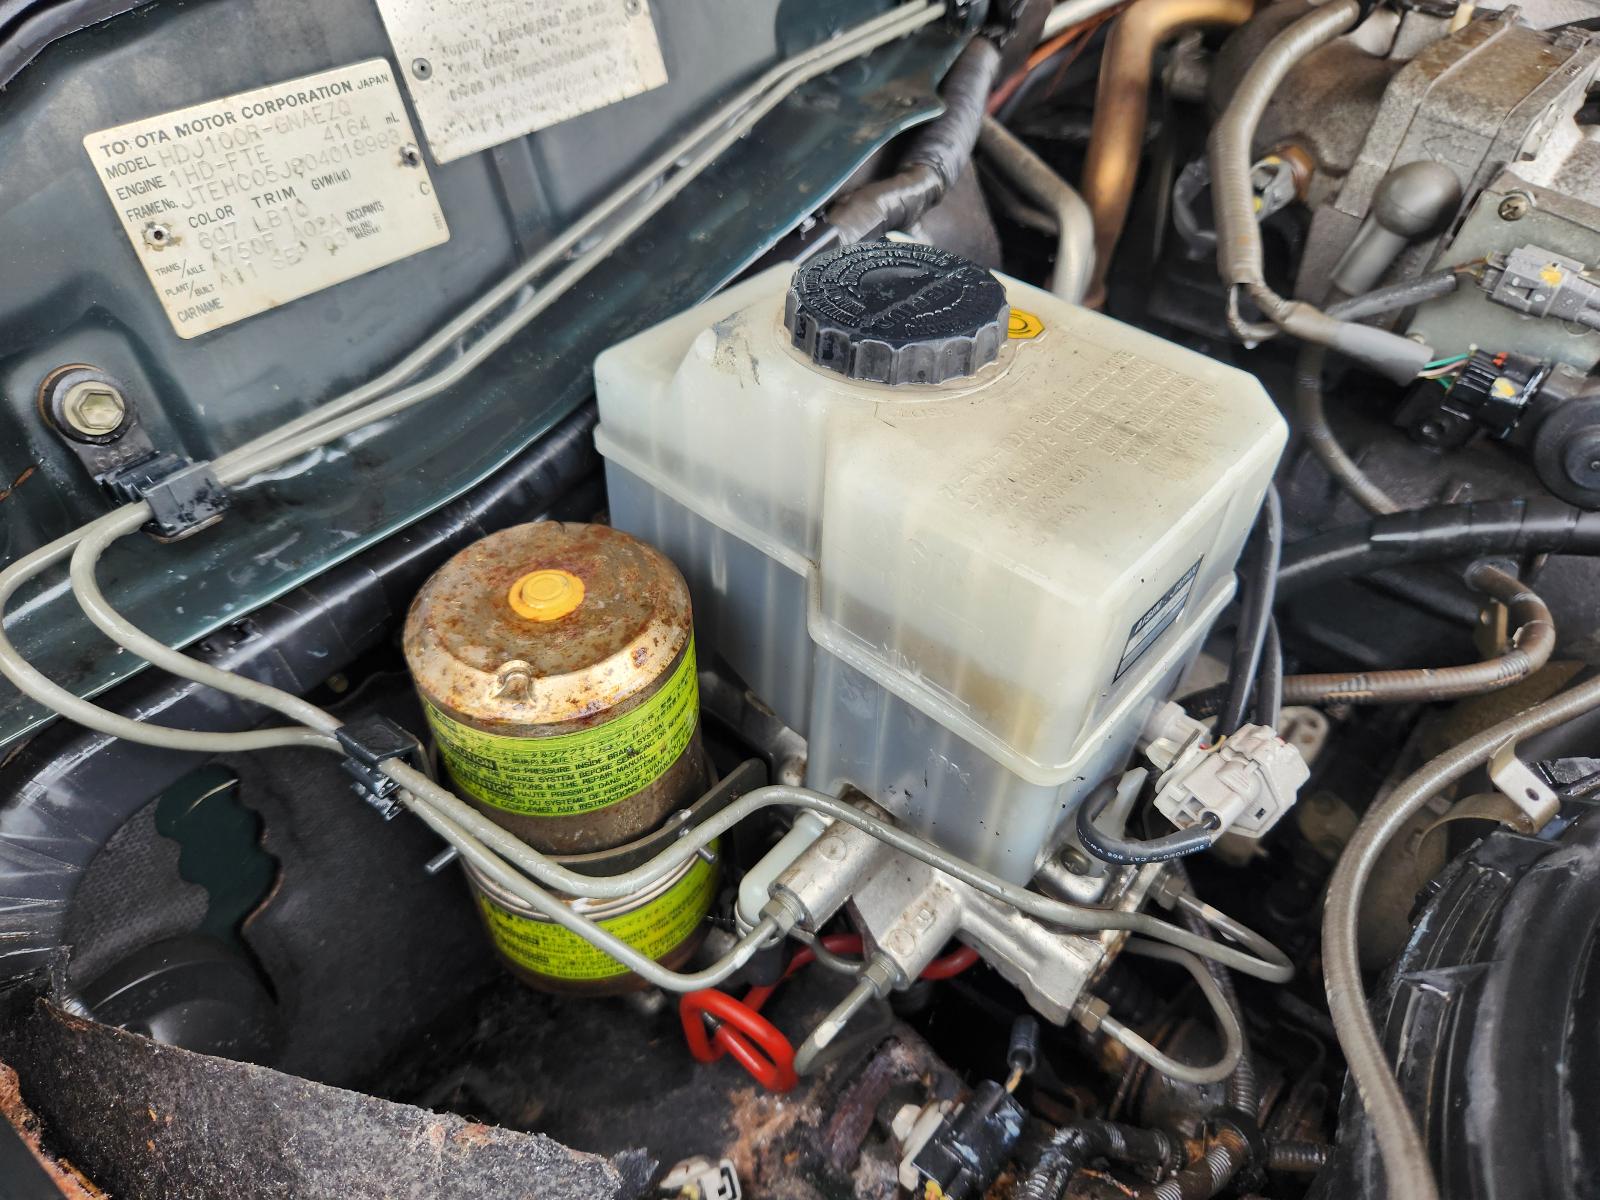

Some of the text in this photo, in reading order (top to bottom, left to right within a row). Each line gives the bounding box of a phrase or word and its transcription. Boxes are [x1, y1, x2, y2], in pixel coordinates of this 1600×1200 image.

[174, 111, 237, 138] MOTOR
[242, 80, 353, 119] CORPORATION
[357, 74, 389, 90] JAPAN
[105, 156, 156, 180] MODEL
[116, 176, 166, 200] ENGINE
[170, 144, 271, 187] 1HD-FTE
[324, 116, 370, 143] 4164
[188, 205, 235, 229] COLOR
[251, 186, 296, 209] TRIM
[524, 766, 572, 775] PRESSURE
[575, 757, 604, 770] INSIDE
[637, 722, 664, 745] SYSTEM
[538, 774, 576, 783] SYSTEM
[579, 764, 613, 778] BEFORE
[560, 781, 578, 789] THE
[582, 771, 613, 784] REPAIR
[518, 790, 547, 798] HAUTE
[551, 785, 594, 798] PRESSION
[598, 777, 621, 788] DANS
[544, 797, 584, 806] SYSTEME
[604, 775, 640, 794] FREINAGE
[580, 785, 639, 809] INSTRUCTIONS
